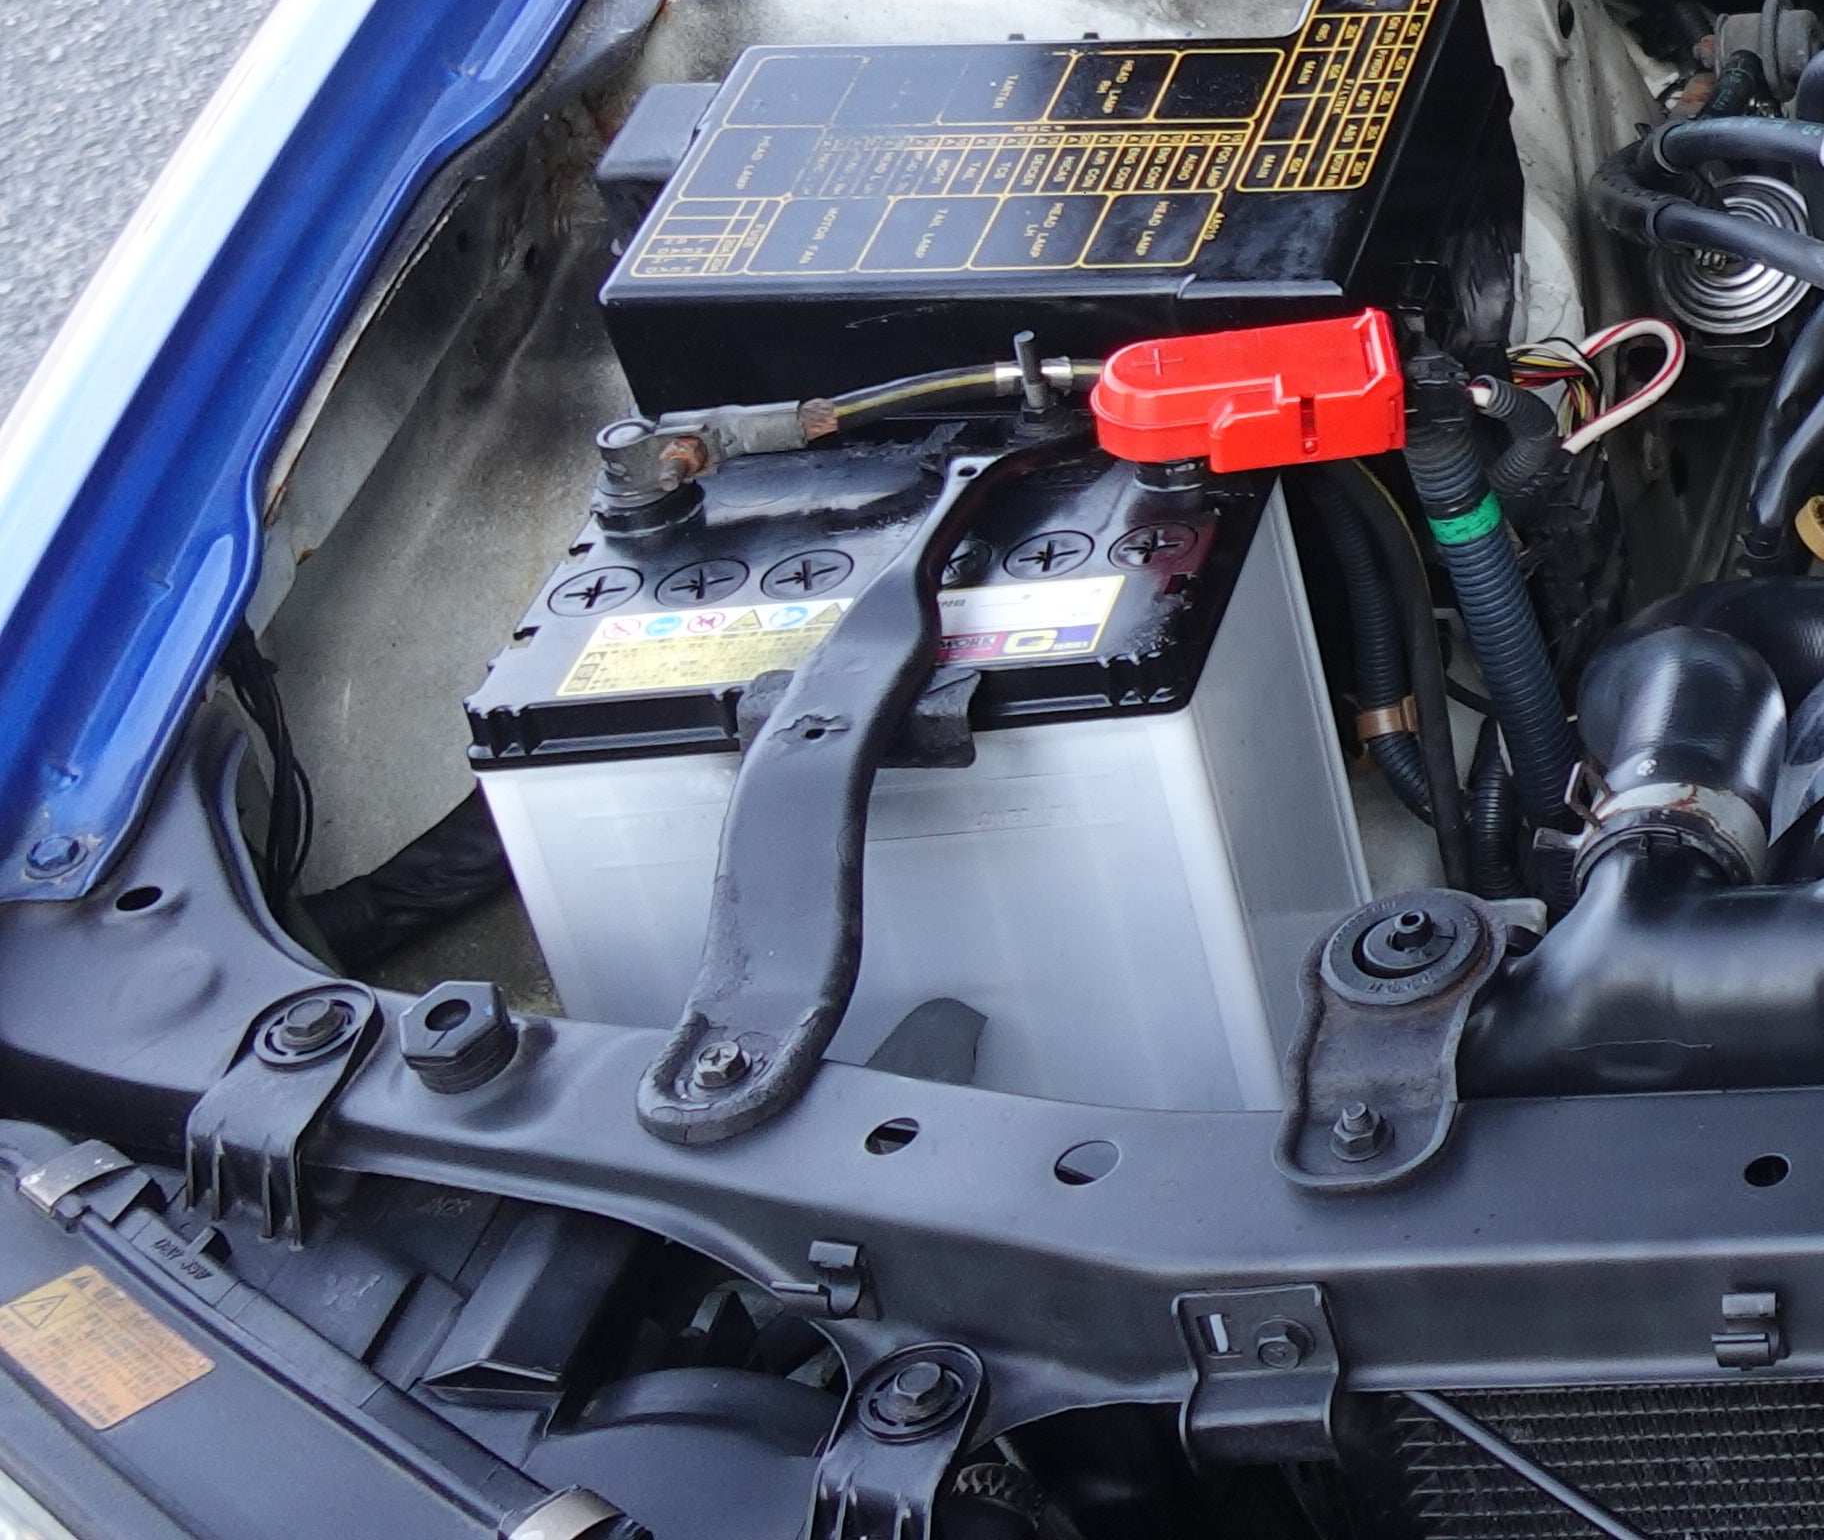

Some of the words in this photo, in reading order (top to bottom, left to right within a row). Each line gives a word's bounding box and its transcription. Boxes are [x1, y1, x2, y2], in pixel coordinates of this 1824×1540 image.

[1116, 60, 1135, 83] HEAD
[1102, 89, 1123, 114] LAMP
[928, 208, 949, 229] TAIL
[1043, 202, 1065, 229] HEAD
[1148, 200, 1171, 227] HEAD
[914, 232, 936, 259] LAMP
[1029, 232, 1050, 258] LAMP
[1135, 230, 1156, 257] LAMP
